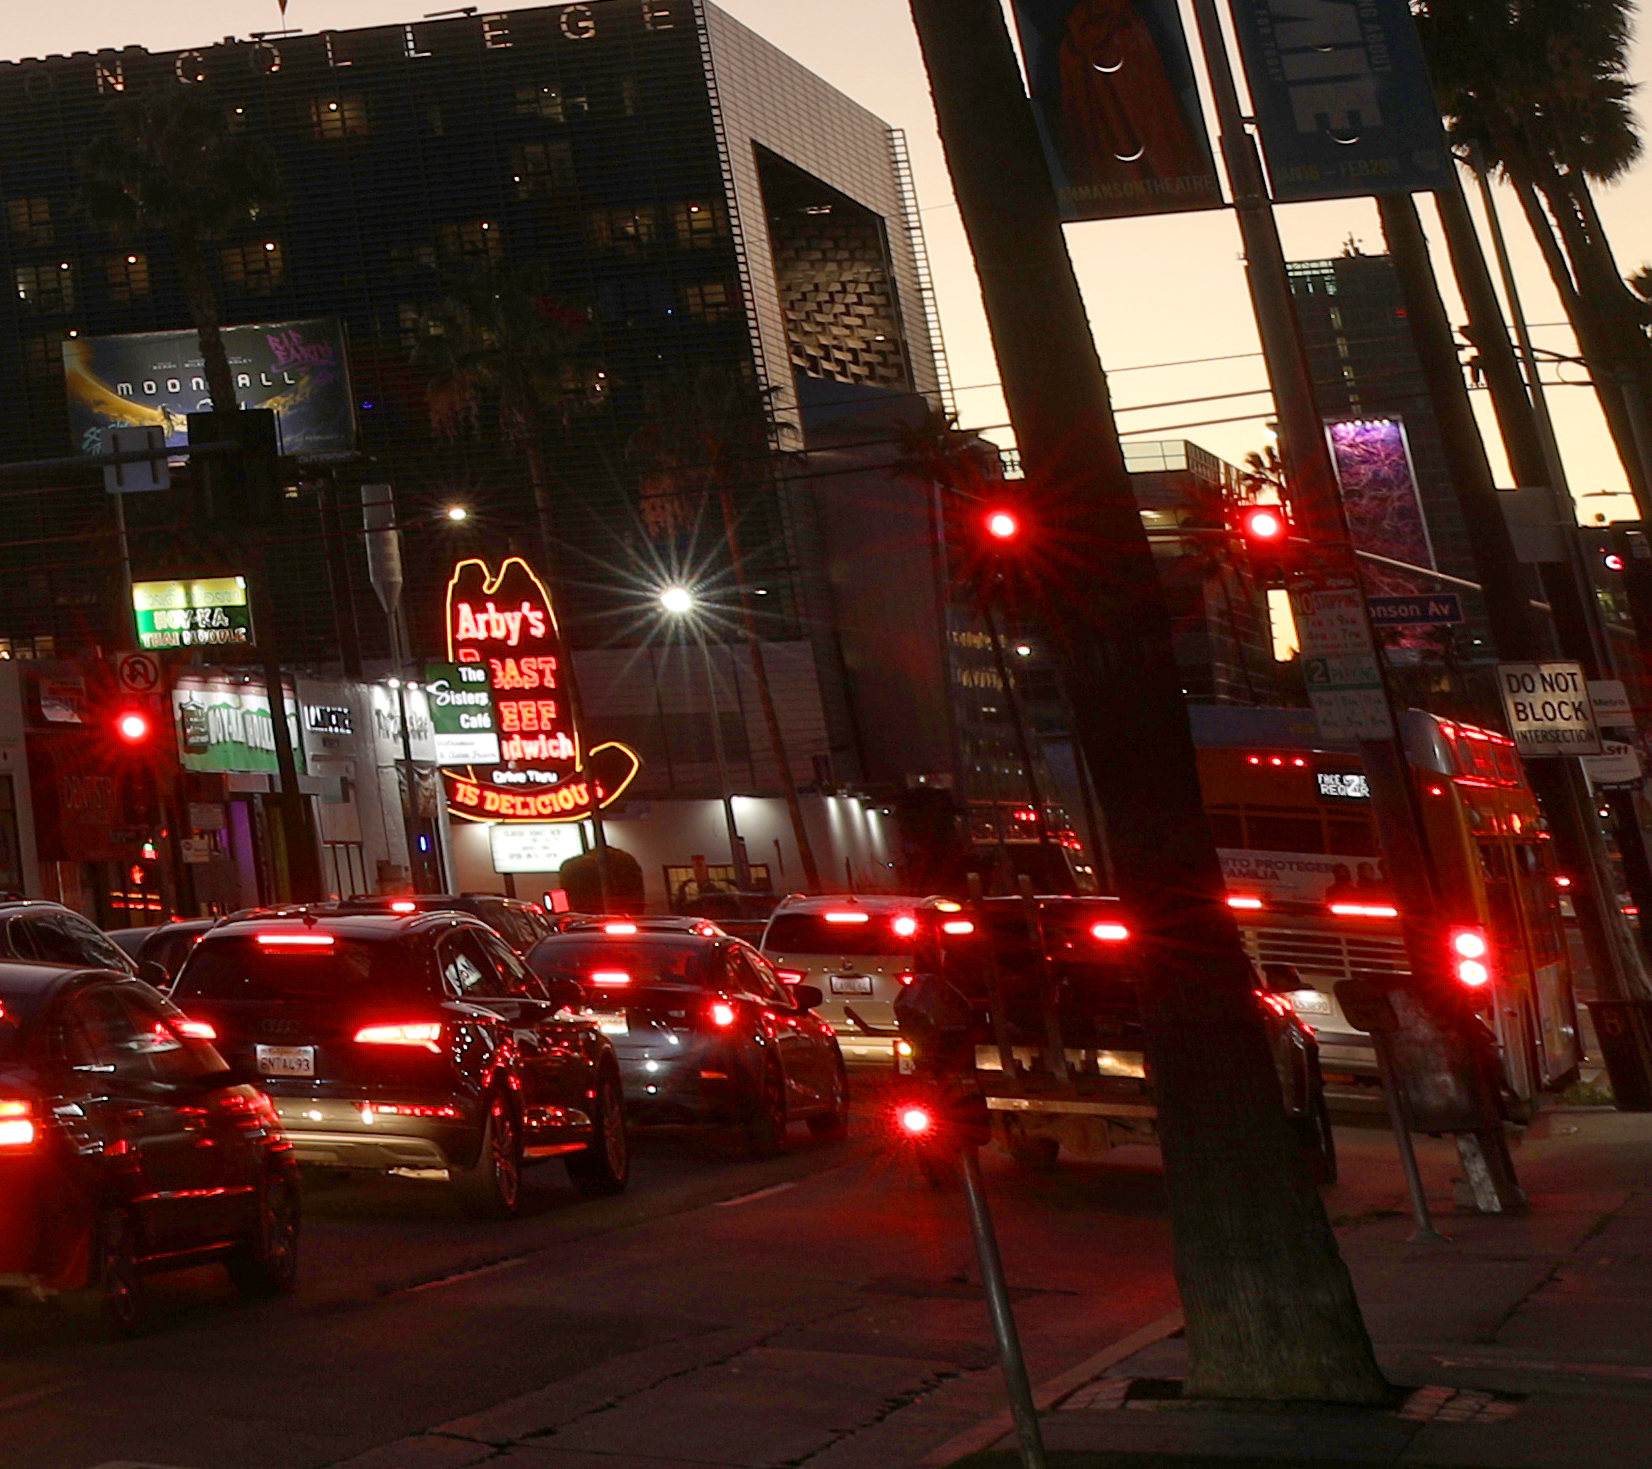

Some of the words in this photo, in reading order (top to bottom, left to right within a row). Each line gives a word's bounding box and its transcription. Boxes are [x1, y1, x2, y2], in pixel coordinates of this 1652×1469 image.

[1364, 24, 1392, 73] ABOUT
[117, 371, 295, 396] MOONALL
[1428, 600, 1451, 616] Av
[455, 601, 546, 646] Arby's
[140, 631, 181, 648] THAI
[182, 627, 247, 646] NOODLE
[458, 666, 486, 682] The
[1506, 672, 1536, 694] DO
[1539, 672, 1579, 693] NOT
[426, 679, 489, 706] Sisters
[459, 712, 492, 730] Café
[499, 699, 557, 733] EEF
[1513, 700, 1589, 722] BLOCK
[501, 731, 576, 761] dwich
[1516, 728, 1597, 744] INTERSECTION
[526, 769, 558, 785] Thru
[455, 782, 480, 806] IS
